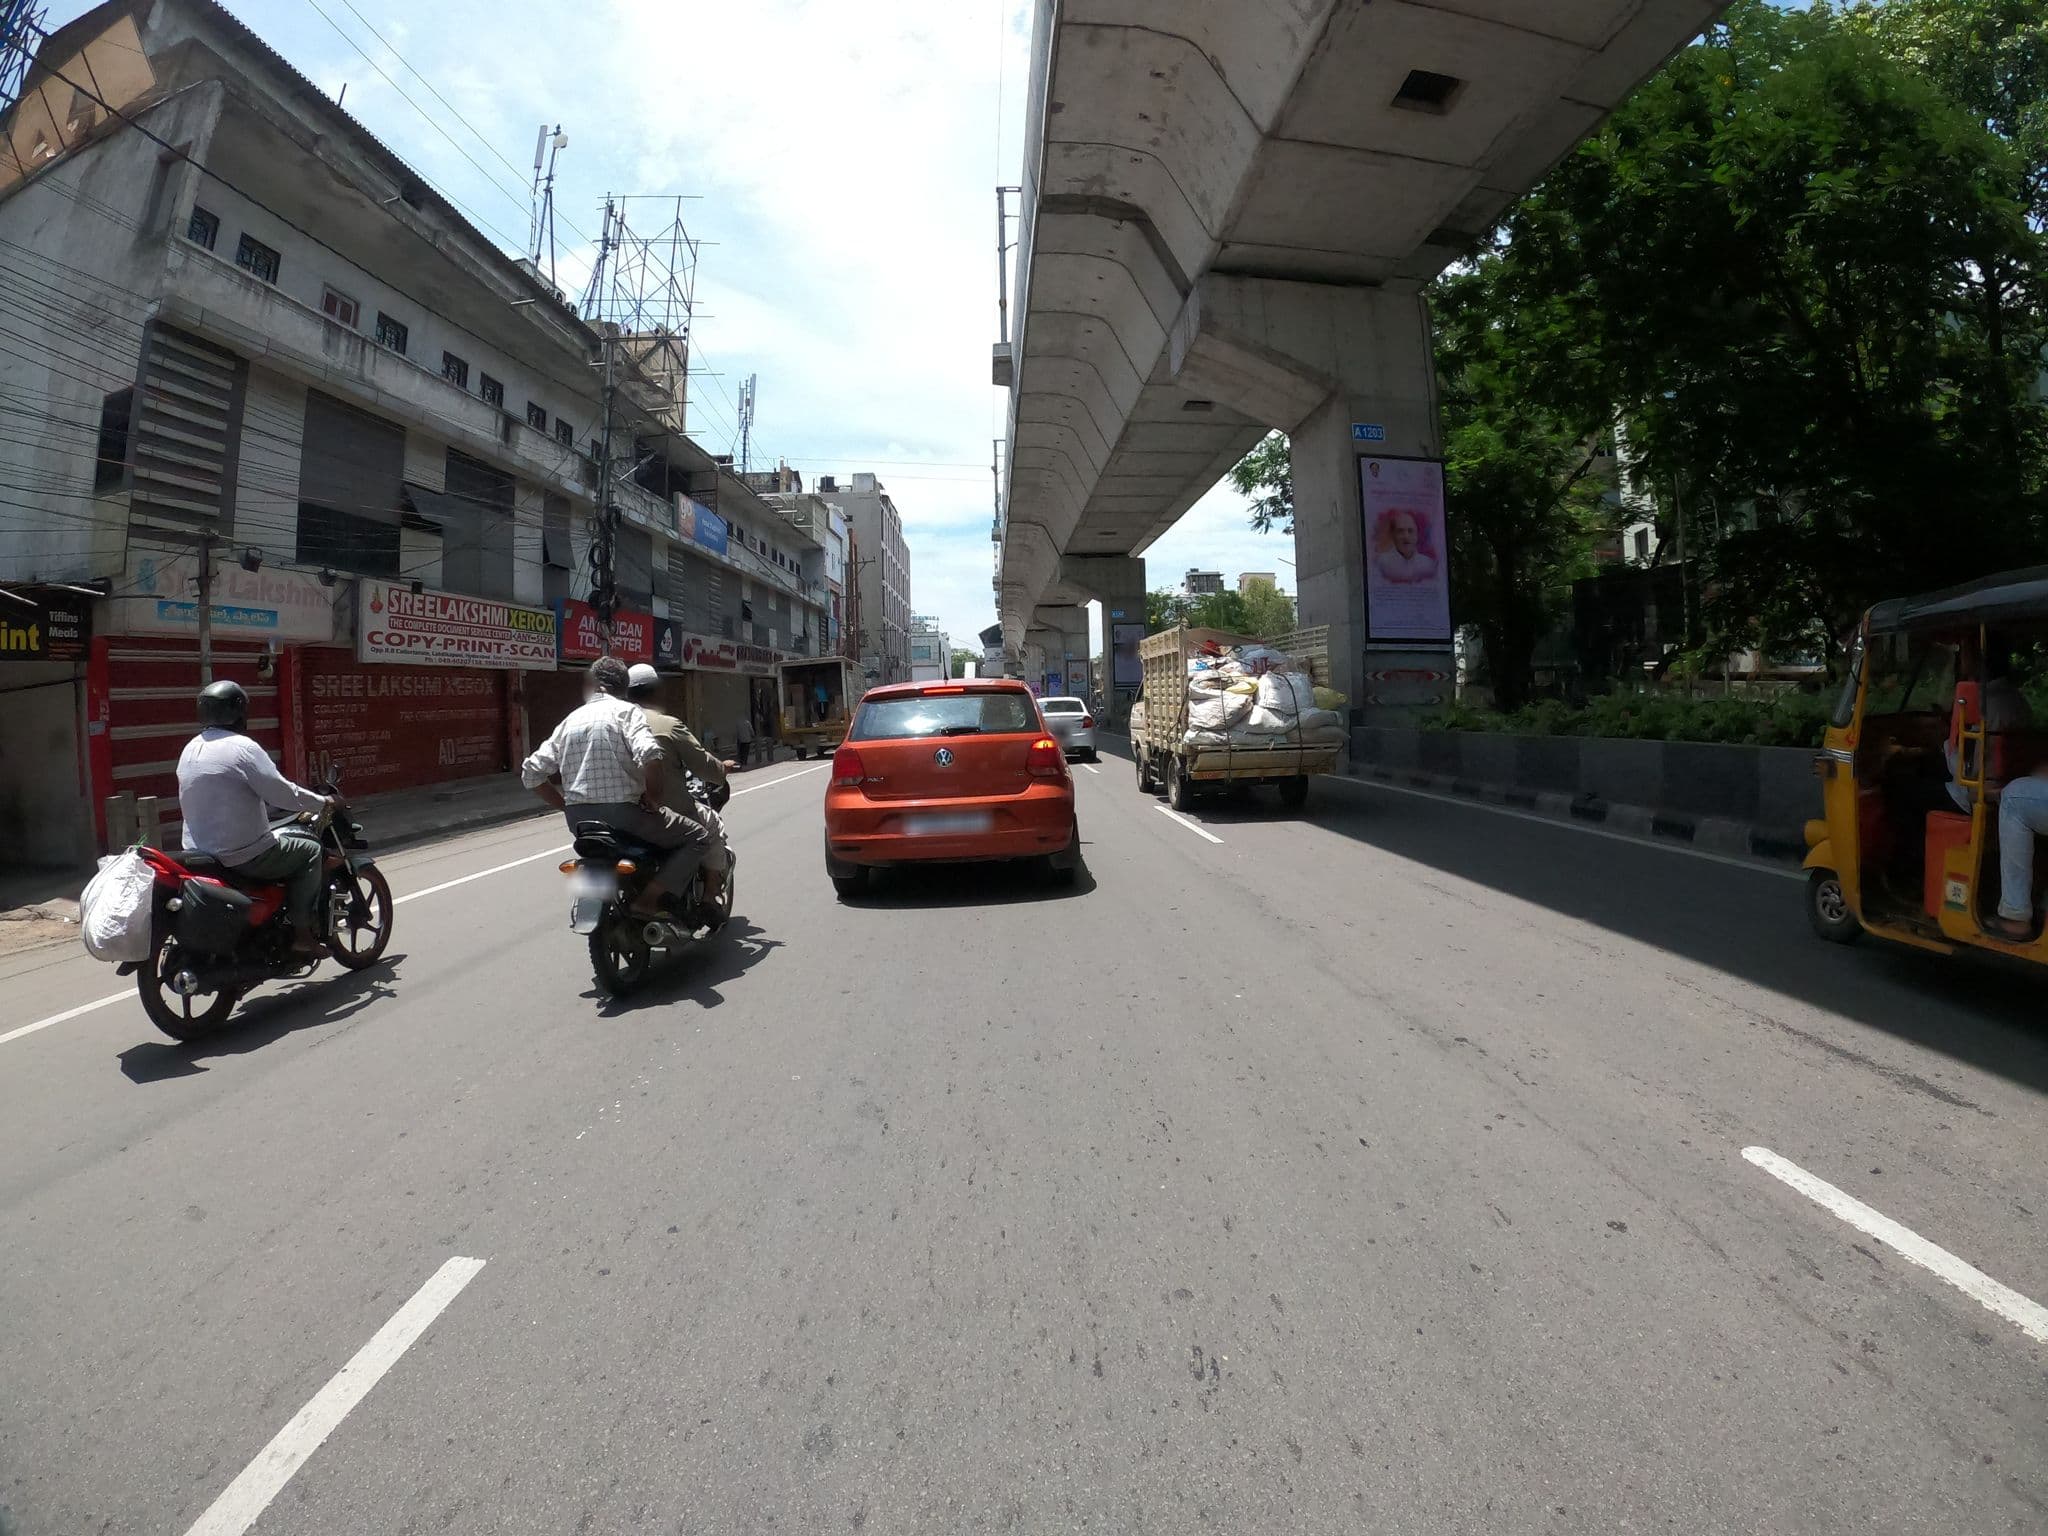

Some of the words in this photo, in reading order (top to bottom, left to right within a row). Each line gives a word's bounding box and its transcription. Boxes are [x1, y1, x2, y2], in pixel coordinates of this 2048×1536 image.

[49, 610, 79, 622] Tiffins
[508, 609, 555, 632] XEROX
[579, 615, 643, 638] AMICAN
[48, 626, 79, 638] Meals
[390, 619, 402, 629] THE
[403, 620, 437, 633] COMPLETE
[437, 623, 470, 636] DOCUMENT
[470, 627, 493, 639] SERVICE
[493, 630, 512, 640] CENTER
[312, 675, 364, 697] SREE
[367, 674, 440, 697] LAKSHMI
